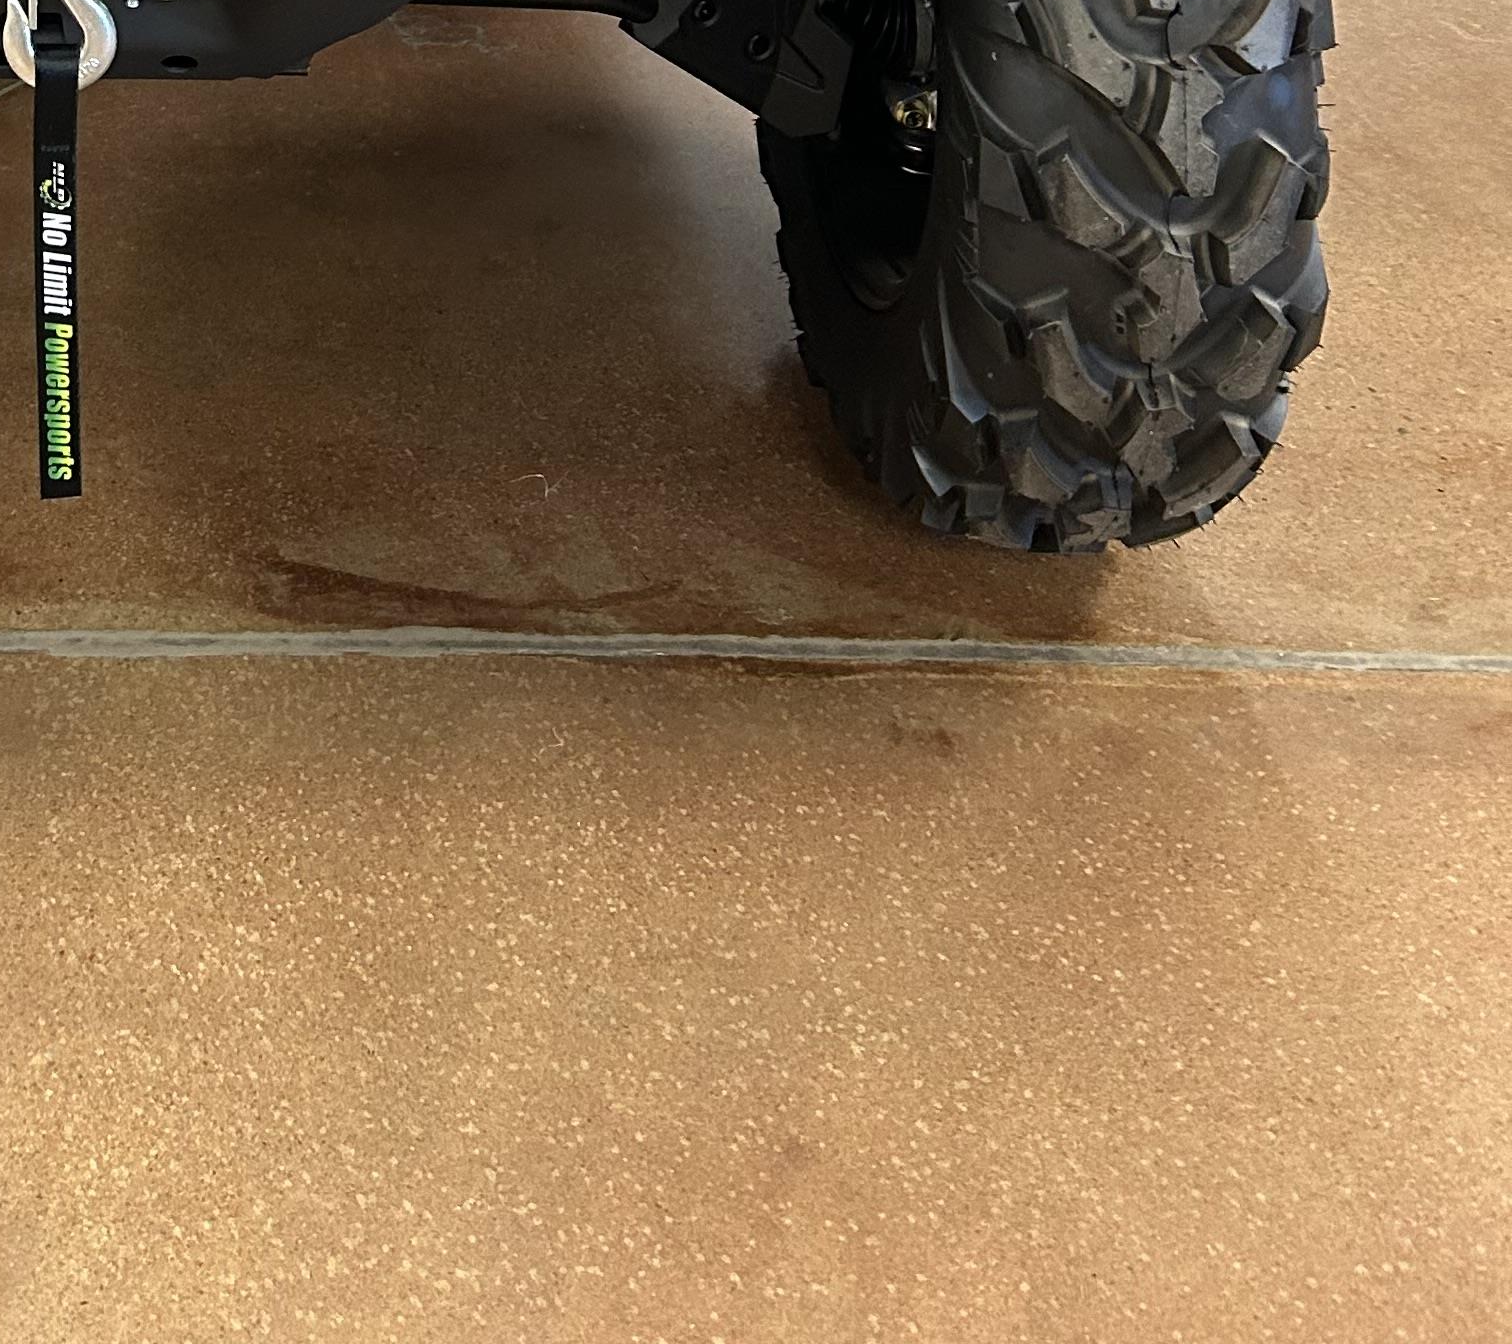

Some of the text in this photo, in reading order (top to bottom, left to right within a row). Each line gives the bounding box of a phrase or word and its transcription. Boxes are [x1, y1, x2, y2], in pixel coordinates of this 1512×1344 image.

[42, 212, 75, 481] No Limit Powersports
